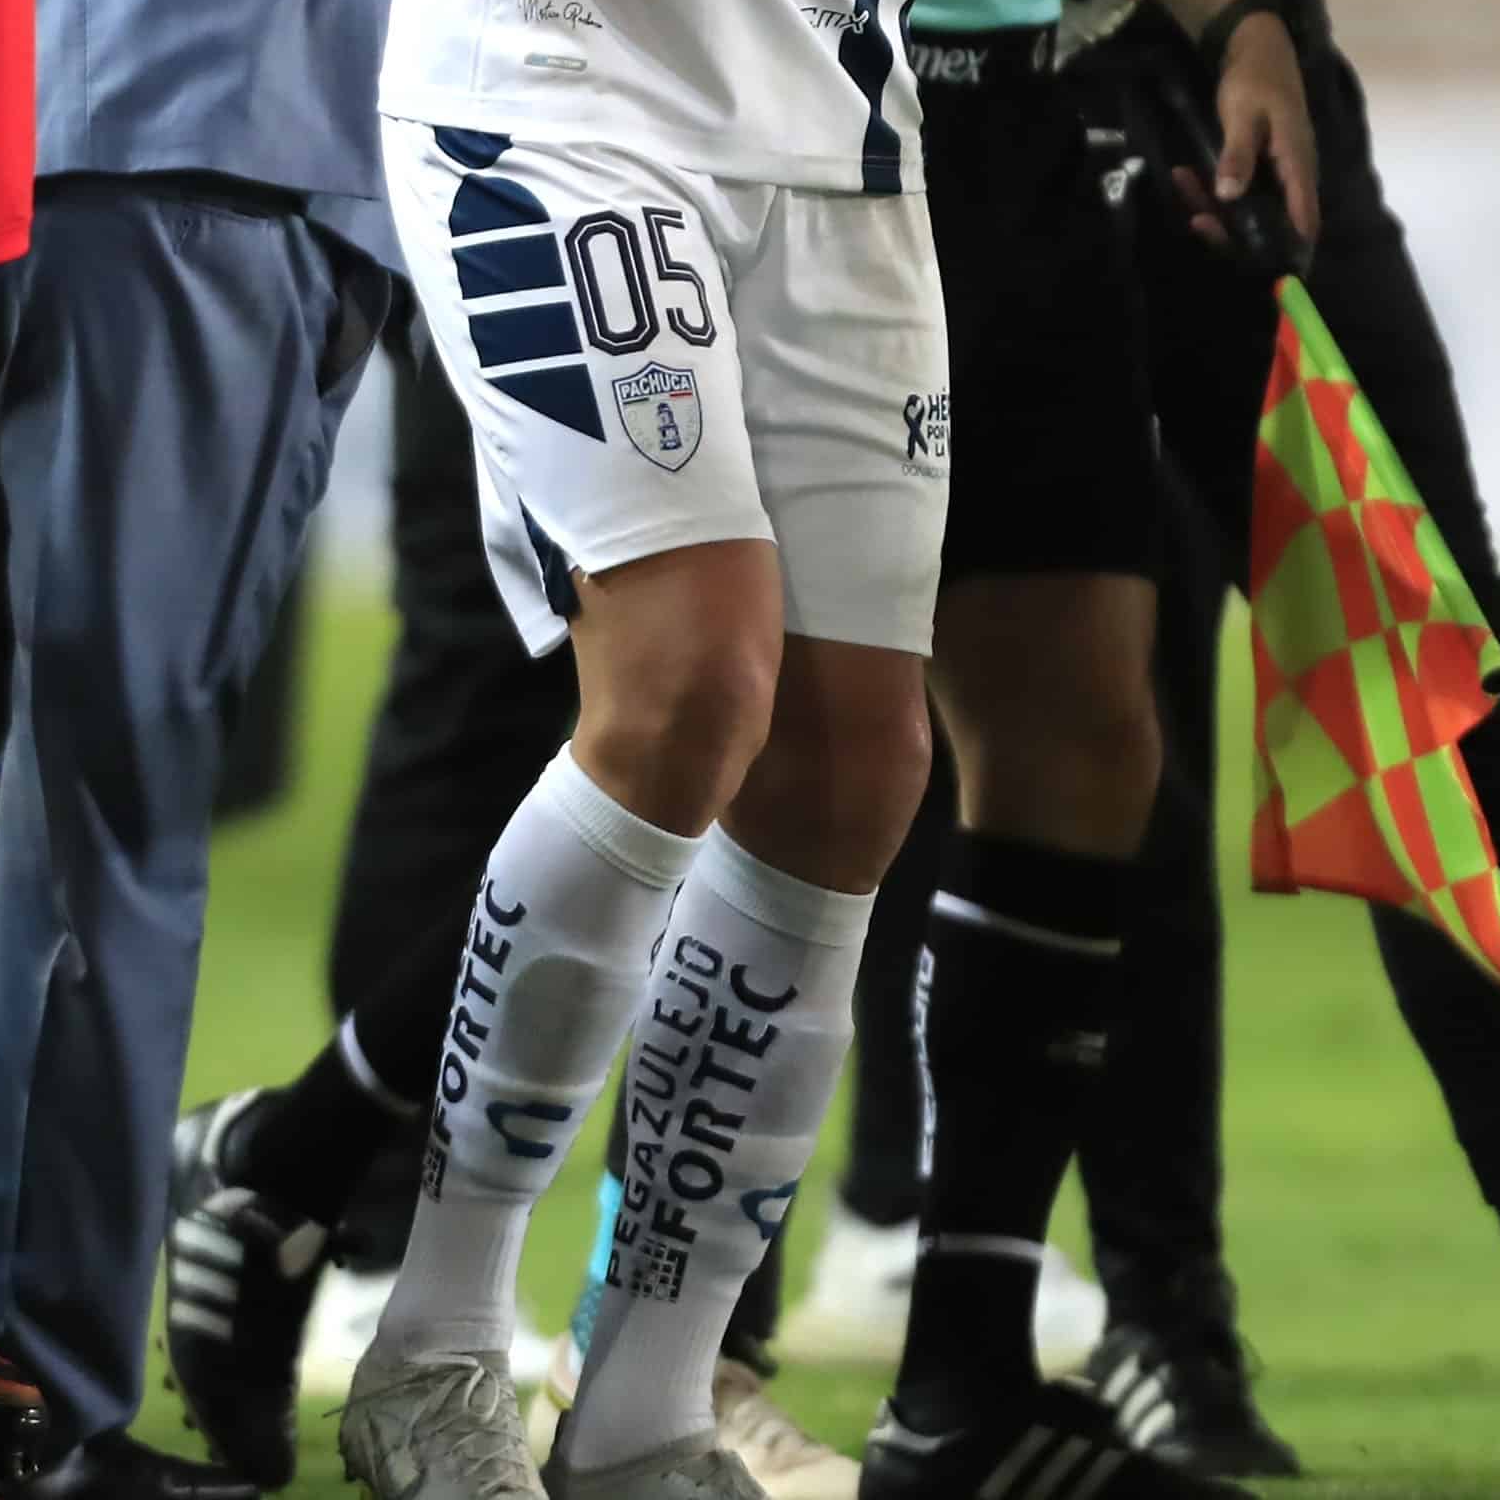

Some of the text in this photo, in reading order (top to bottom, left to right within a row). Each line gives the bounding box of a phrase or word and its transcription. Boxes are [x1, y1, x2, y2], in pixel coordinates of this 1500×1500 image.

[564, 206, 717, 357] 05
[621, 372, 690, 399] PACHUCA
[432, 879, 527, 1147] FORTEC
[605, 934, 723, 1289] PEGAZULEJO
[651, 963, 798, 1245] FORTEC
